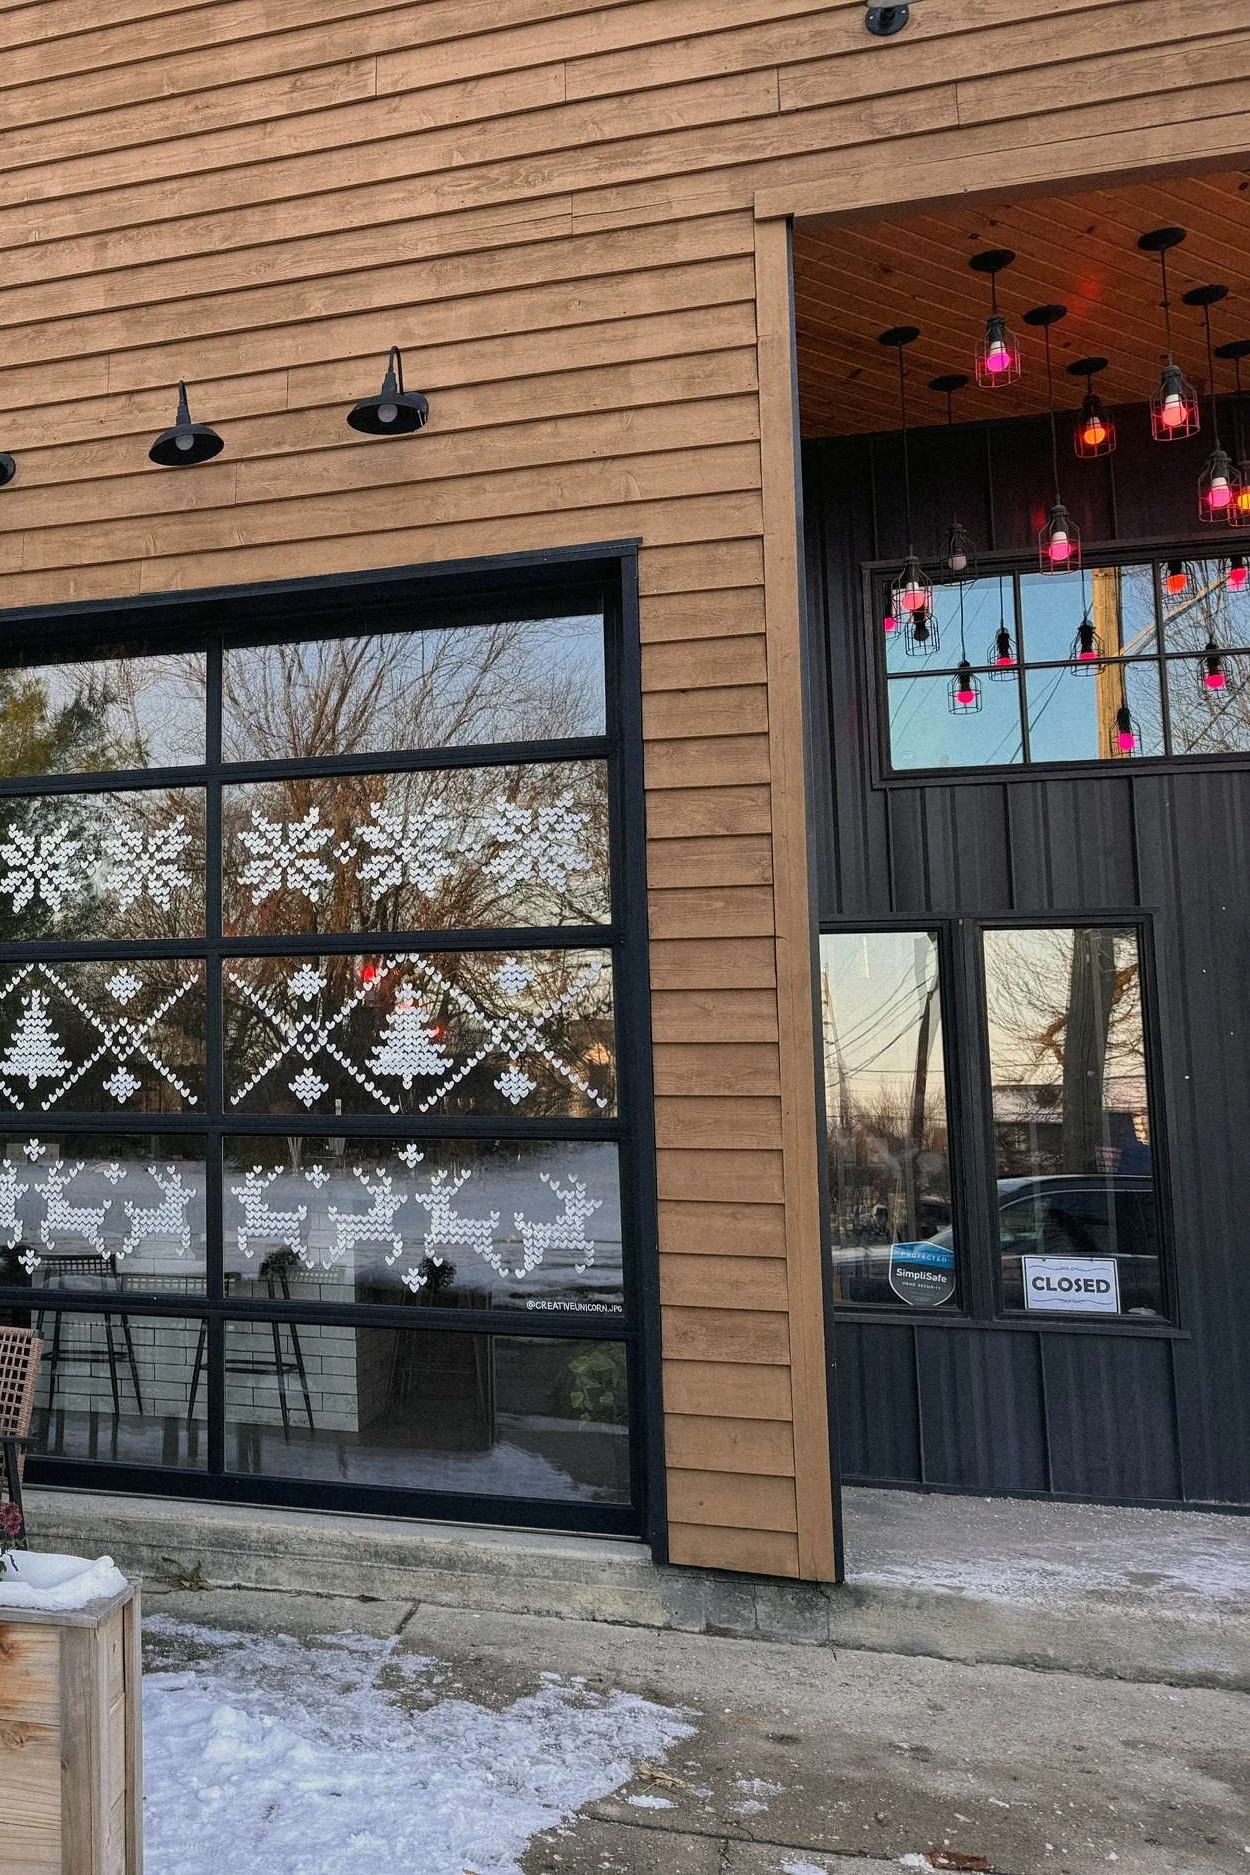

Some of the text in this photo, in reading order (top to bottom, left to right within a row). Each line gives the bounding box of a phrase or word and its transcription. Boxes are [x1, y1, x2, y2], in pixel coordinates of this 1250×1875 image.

[901, 1251, 947, 1263] PROTECTED
[896, 1267, 948, 1283] SimpliSafe
[1032, 1276, 1111, 1294] CLOSED
